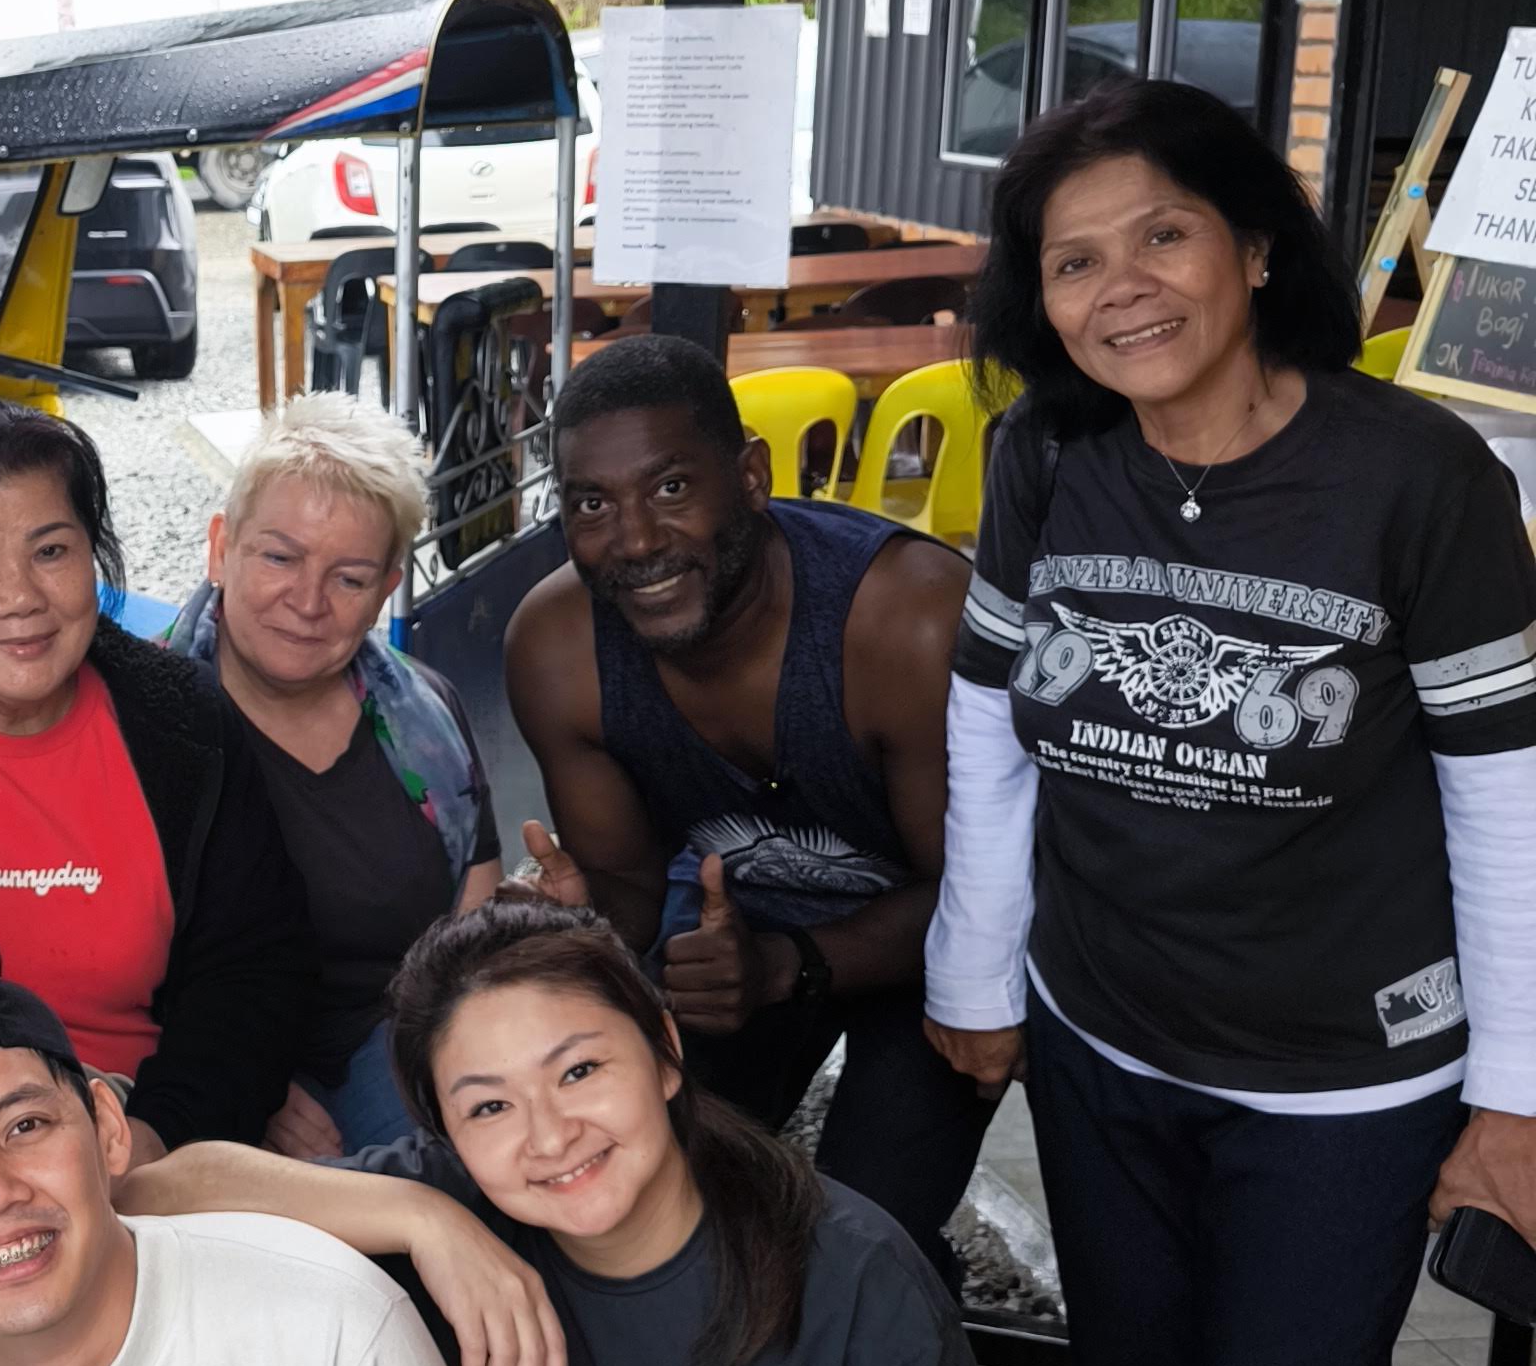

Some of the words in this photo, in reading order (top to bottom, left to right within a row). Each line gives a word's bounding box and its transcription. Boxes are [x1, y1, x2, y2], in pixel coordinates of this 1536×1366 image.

[1474, 212, 1536, 244] THAN
[1166, 563, 1391, 645] UNIVERSITY
[1234, 665, 1360, 751] 69
[1037, 739, 1068, 758] The
[1070, 751, 1131, 776] country
[1134, 763, 1150, 777] of
[1152, 764, 1229, 790] Zanzibar
[1263, 786, 1302, 798] part
[1070, 719, 1167, 761] INDIAN
[1175, 741, 1267, 779] OCEAN
